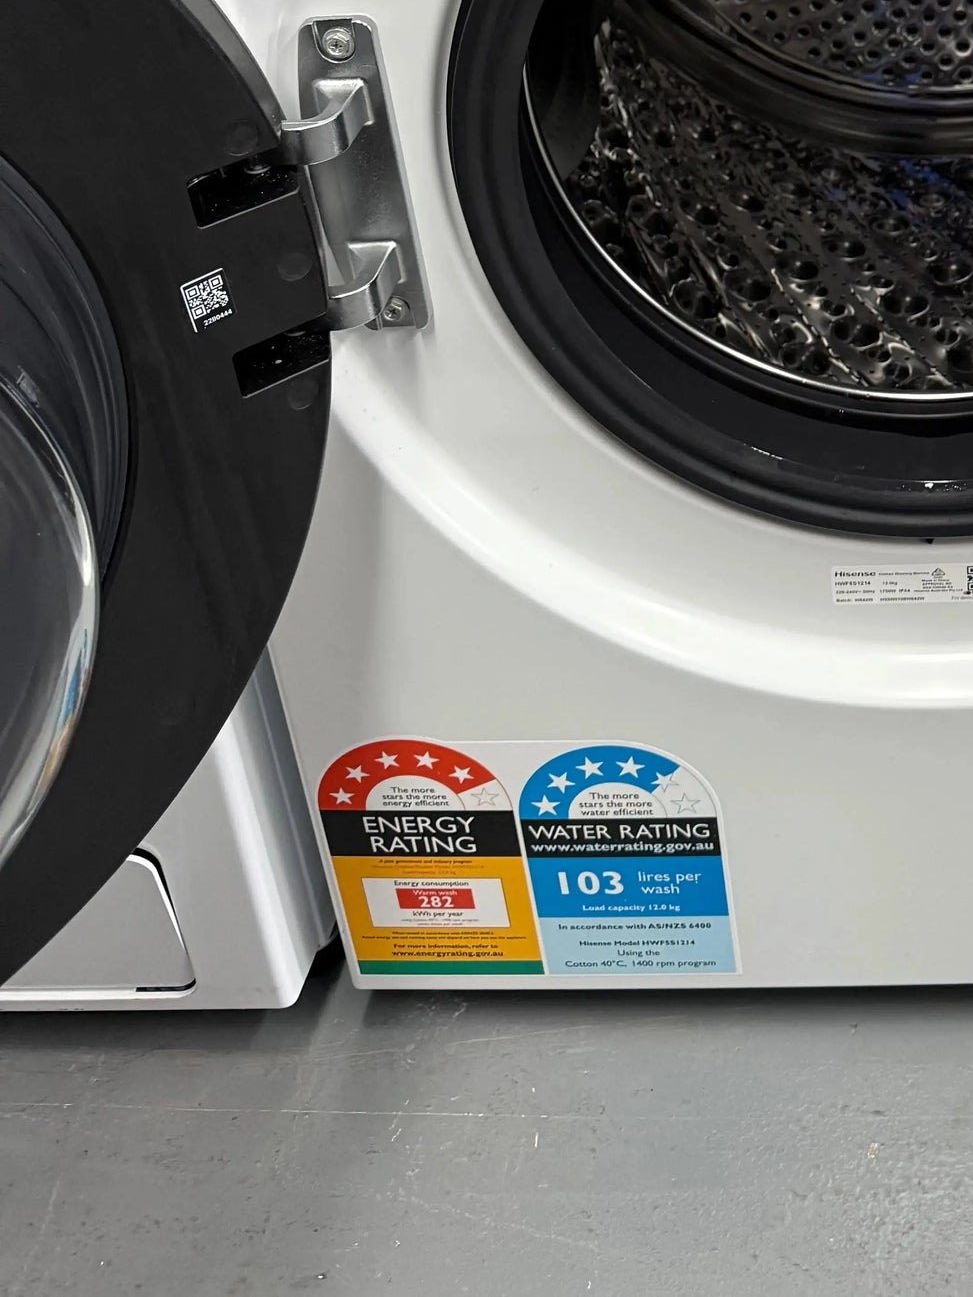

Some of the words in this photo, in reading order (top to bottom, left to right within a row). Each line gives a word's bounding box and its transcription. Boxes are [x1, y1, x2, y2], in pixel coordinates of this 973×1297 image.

[834, 570, 876, 578] Hisense
[589, 792, 610, 800] The
[382, 800, 413, 808] energy
[606, 800, 623, 808] the
[613, 808, 654, 816] efficient
[362, 816, 475, 834] ENERGY
[528, 824, 611, 840] WATER
[619, 823, 710, 839] RATING
[370, 836, 477, 853] RATING
[531, 841, 714, 853] www.waterrating.gov.au
[557, 870, 624, 895] 103
[638, 871, 670, 882] lires
[676, 873, 702, 884] per
[641, 884, 680, 894] wash
[418, 896, 454, 908] 282
[608, 904, 645, 912] capacity
[669, 904, 681, 912] kg
[677, 960, 717, 968] program
